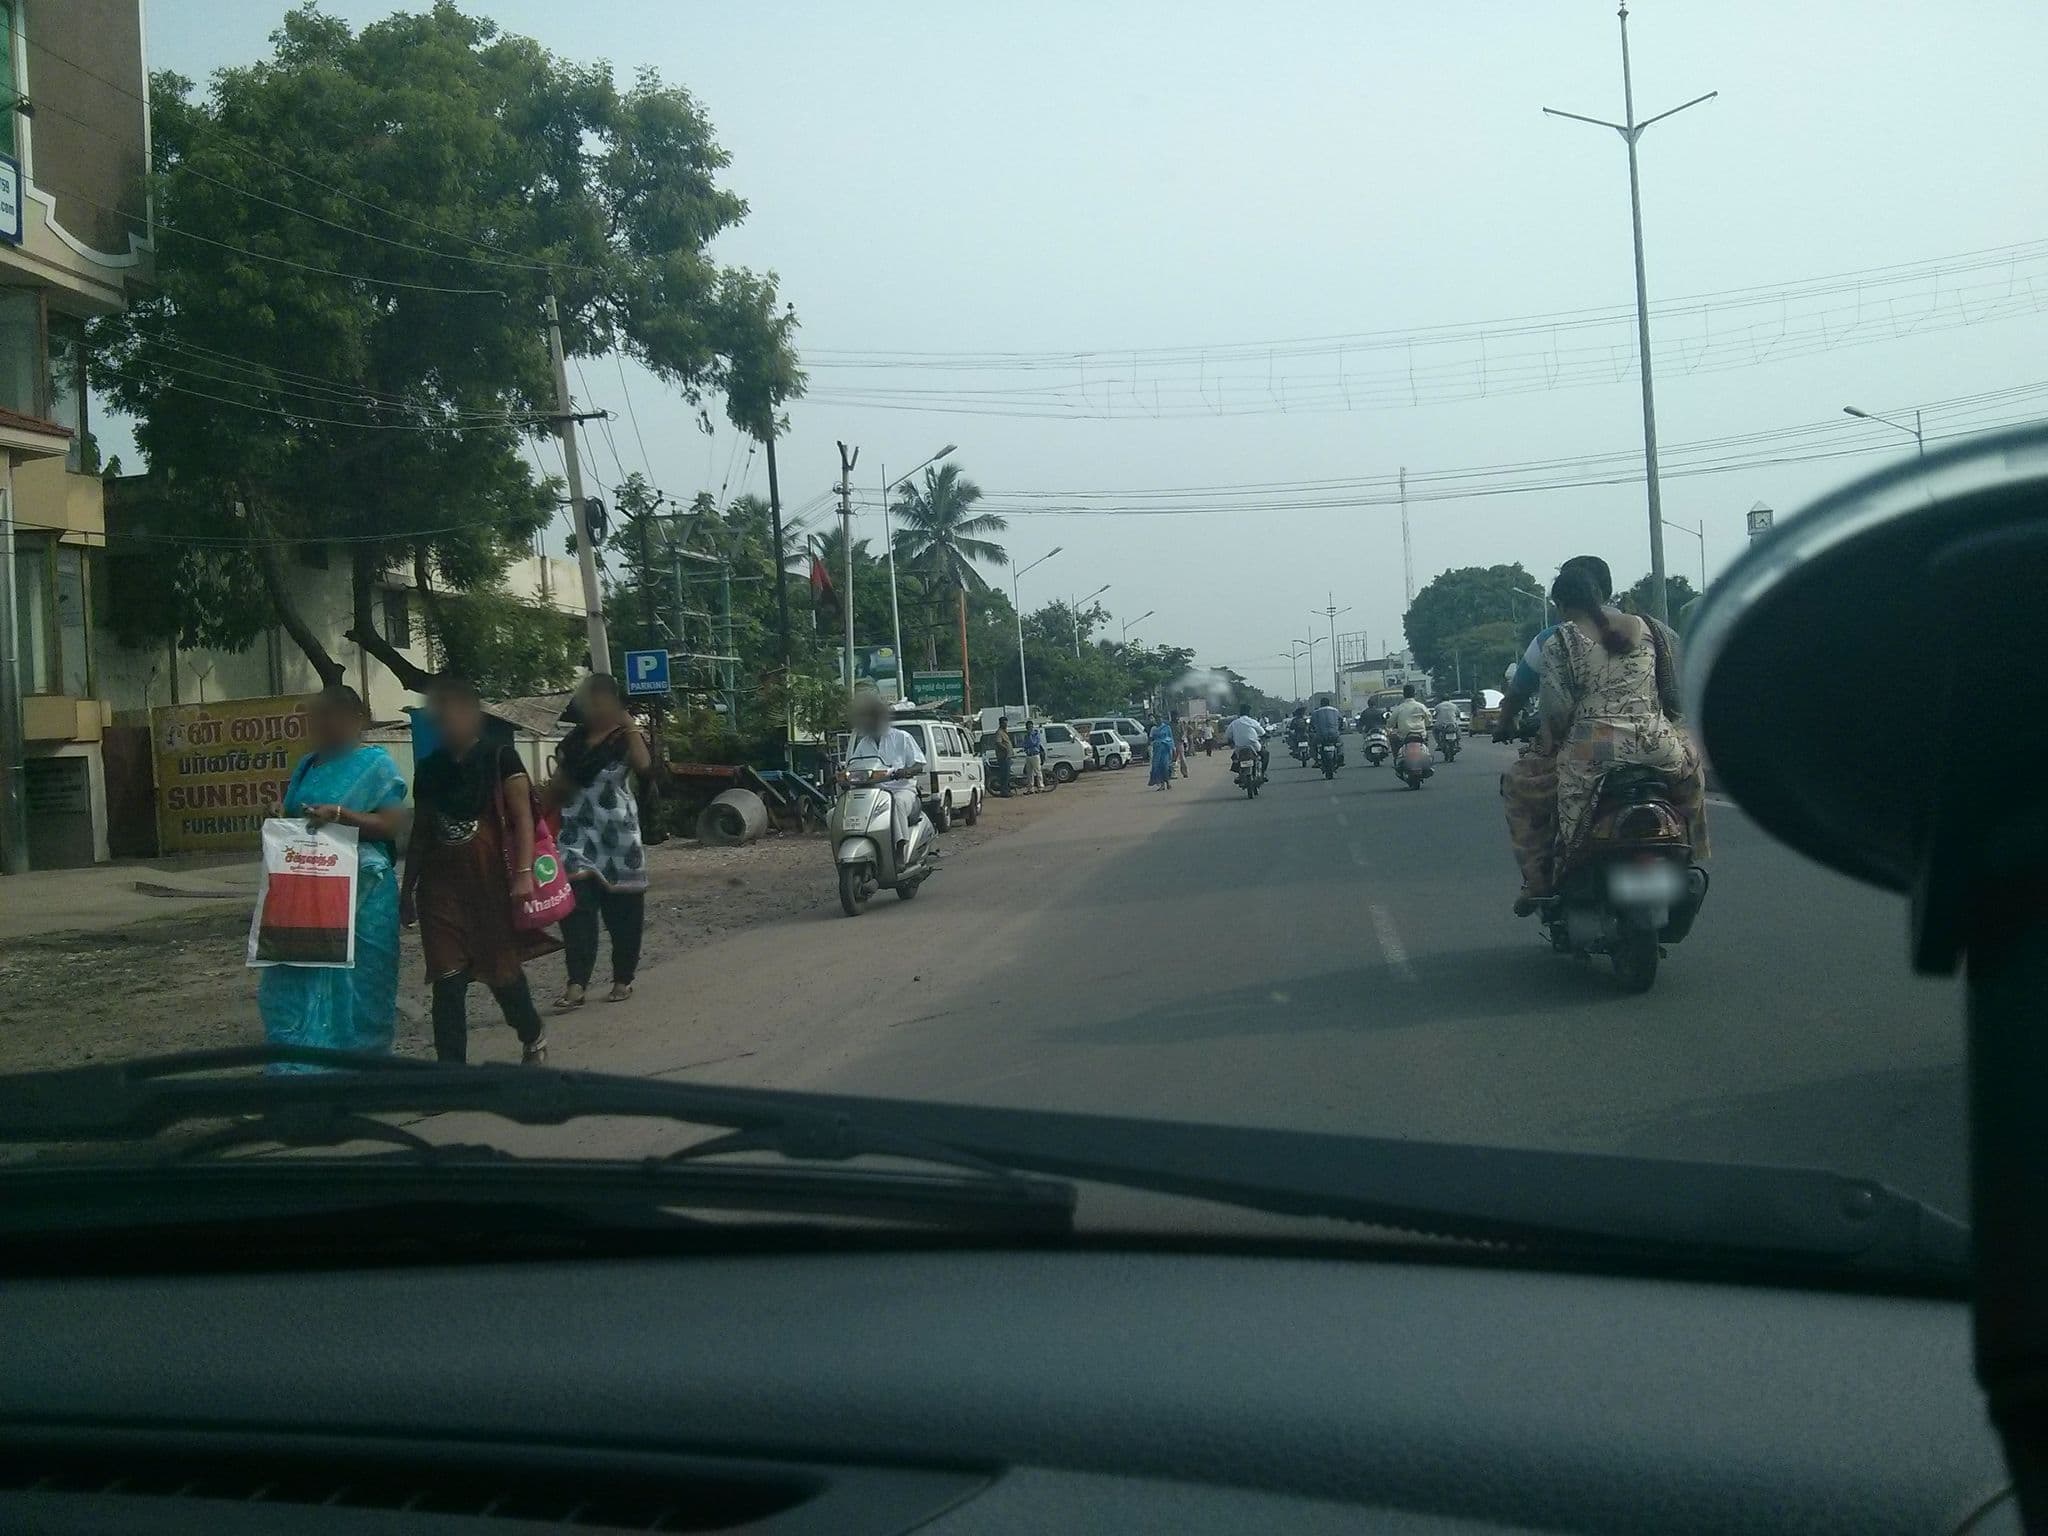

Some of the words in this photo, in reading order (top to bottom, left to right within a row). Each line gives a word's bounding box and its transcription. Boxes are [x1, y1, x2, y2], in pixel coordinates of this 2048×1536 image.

[637, 655, 658, 680] P
[630, 681, 668, 691] PARKING
[183, 815, 264, 834] FURNITU
